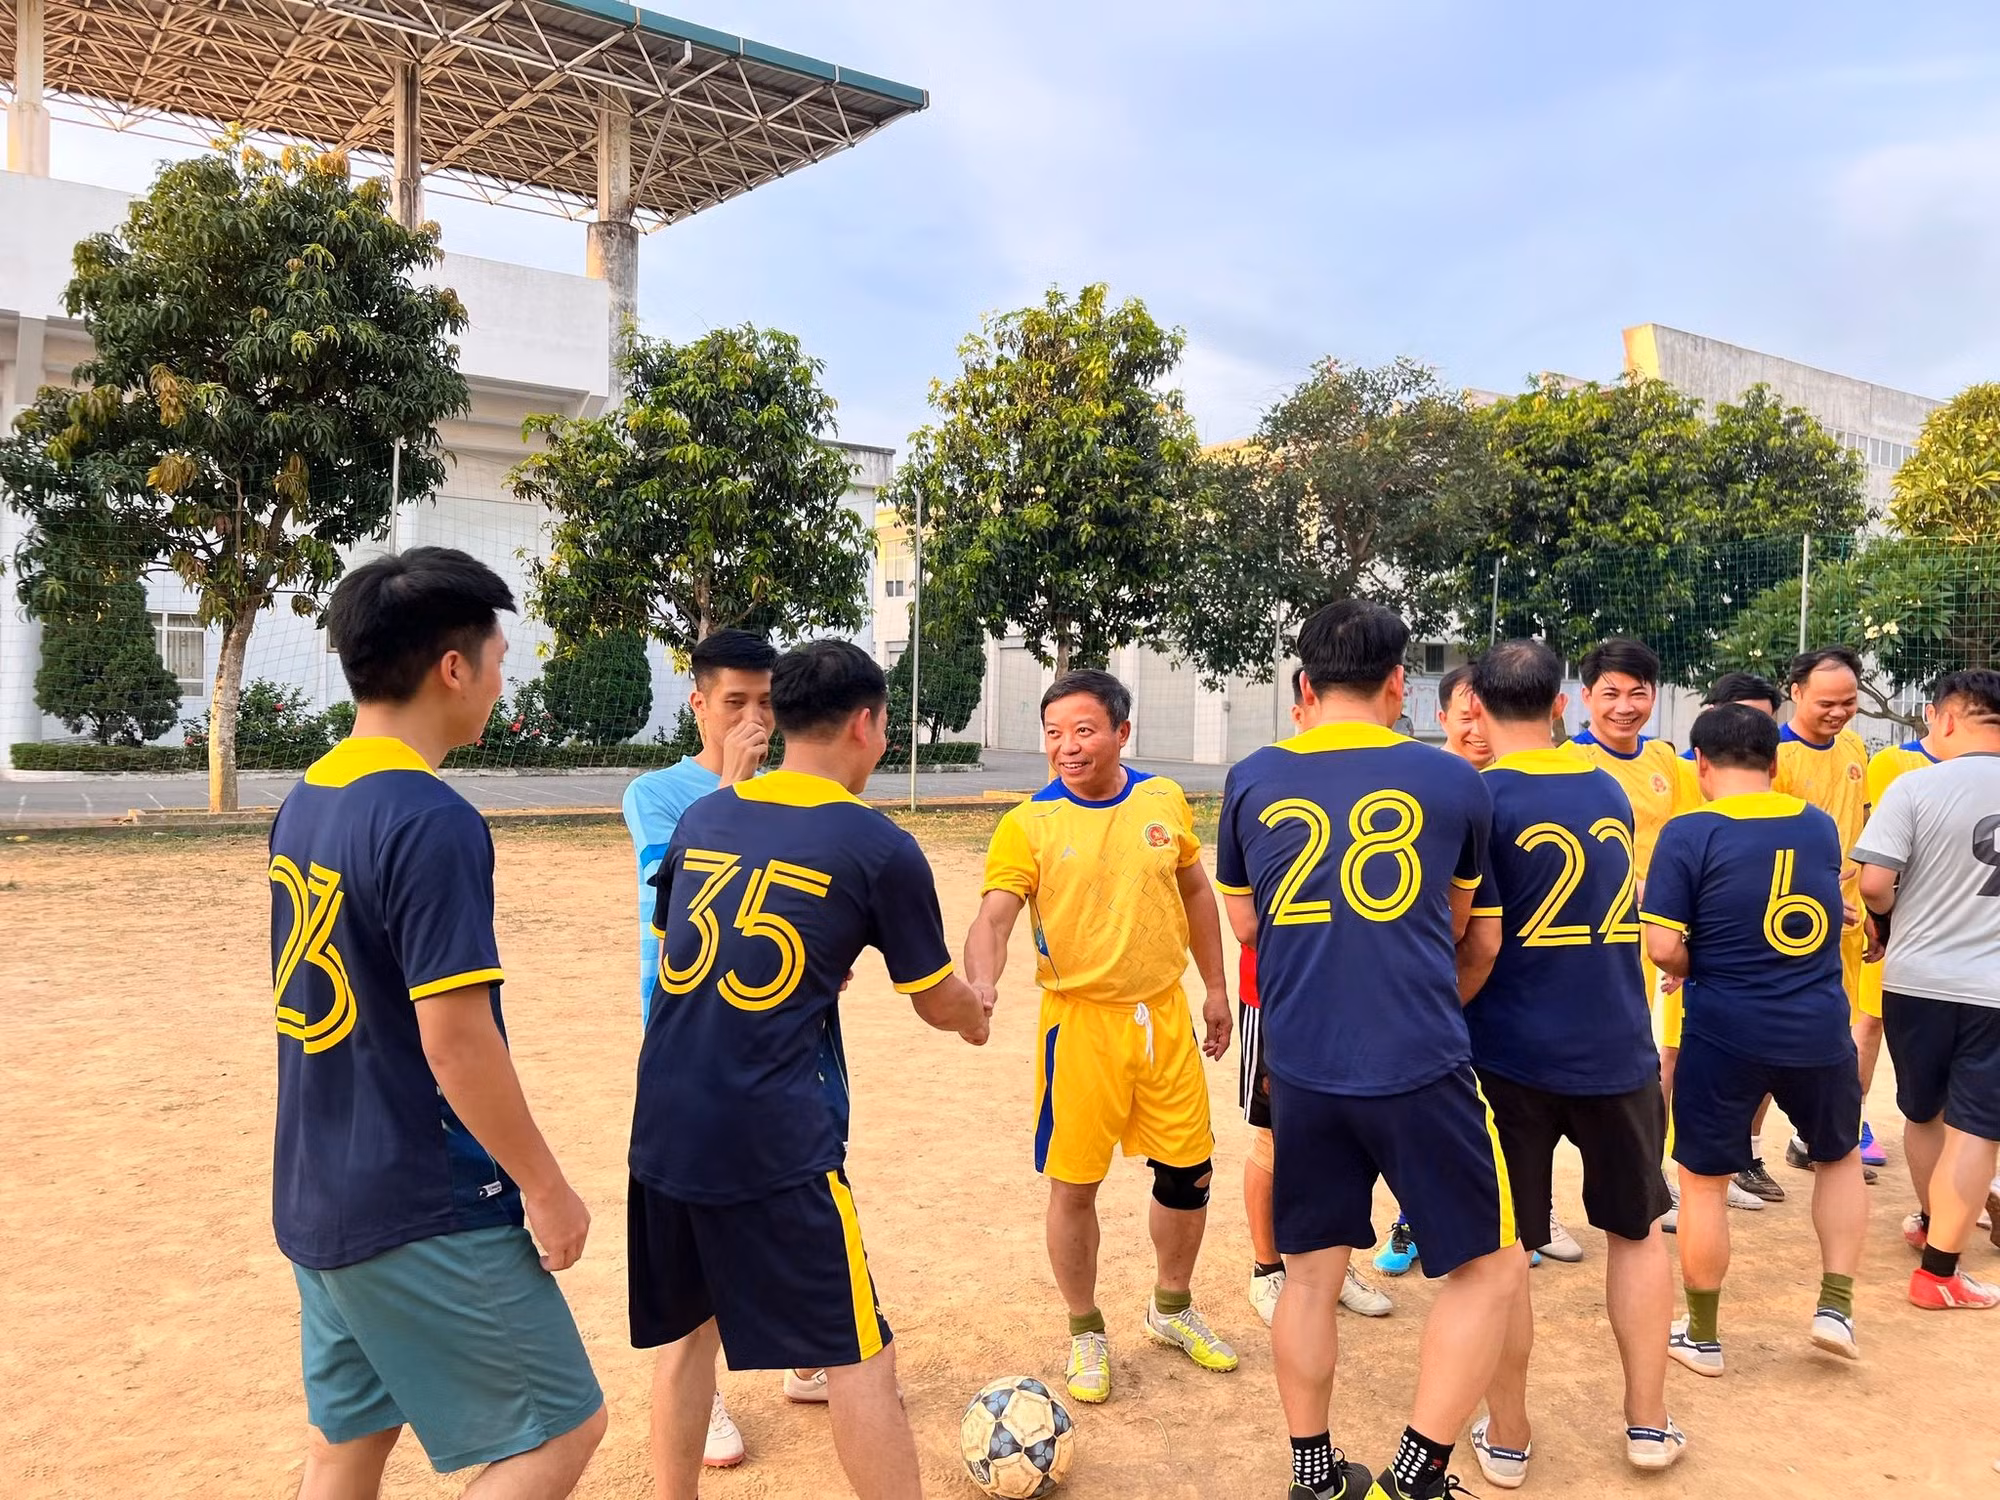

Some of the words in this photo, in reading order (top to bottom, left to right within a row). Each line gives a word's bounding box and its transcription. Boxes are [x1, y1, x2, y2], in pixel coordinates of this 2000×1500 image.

[1258, 789, 1424, 926] 28
[1515, 817, 1640, 947] 22
[1762, 849, 1829, 957] 6
[268, 855, 358, 1054] 23
[658, 849, 833, 1011] 35
